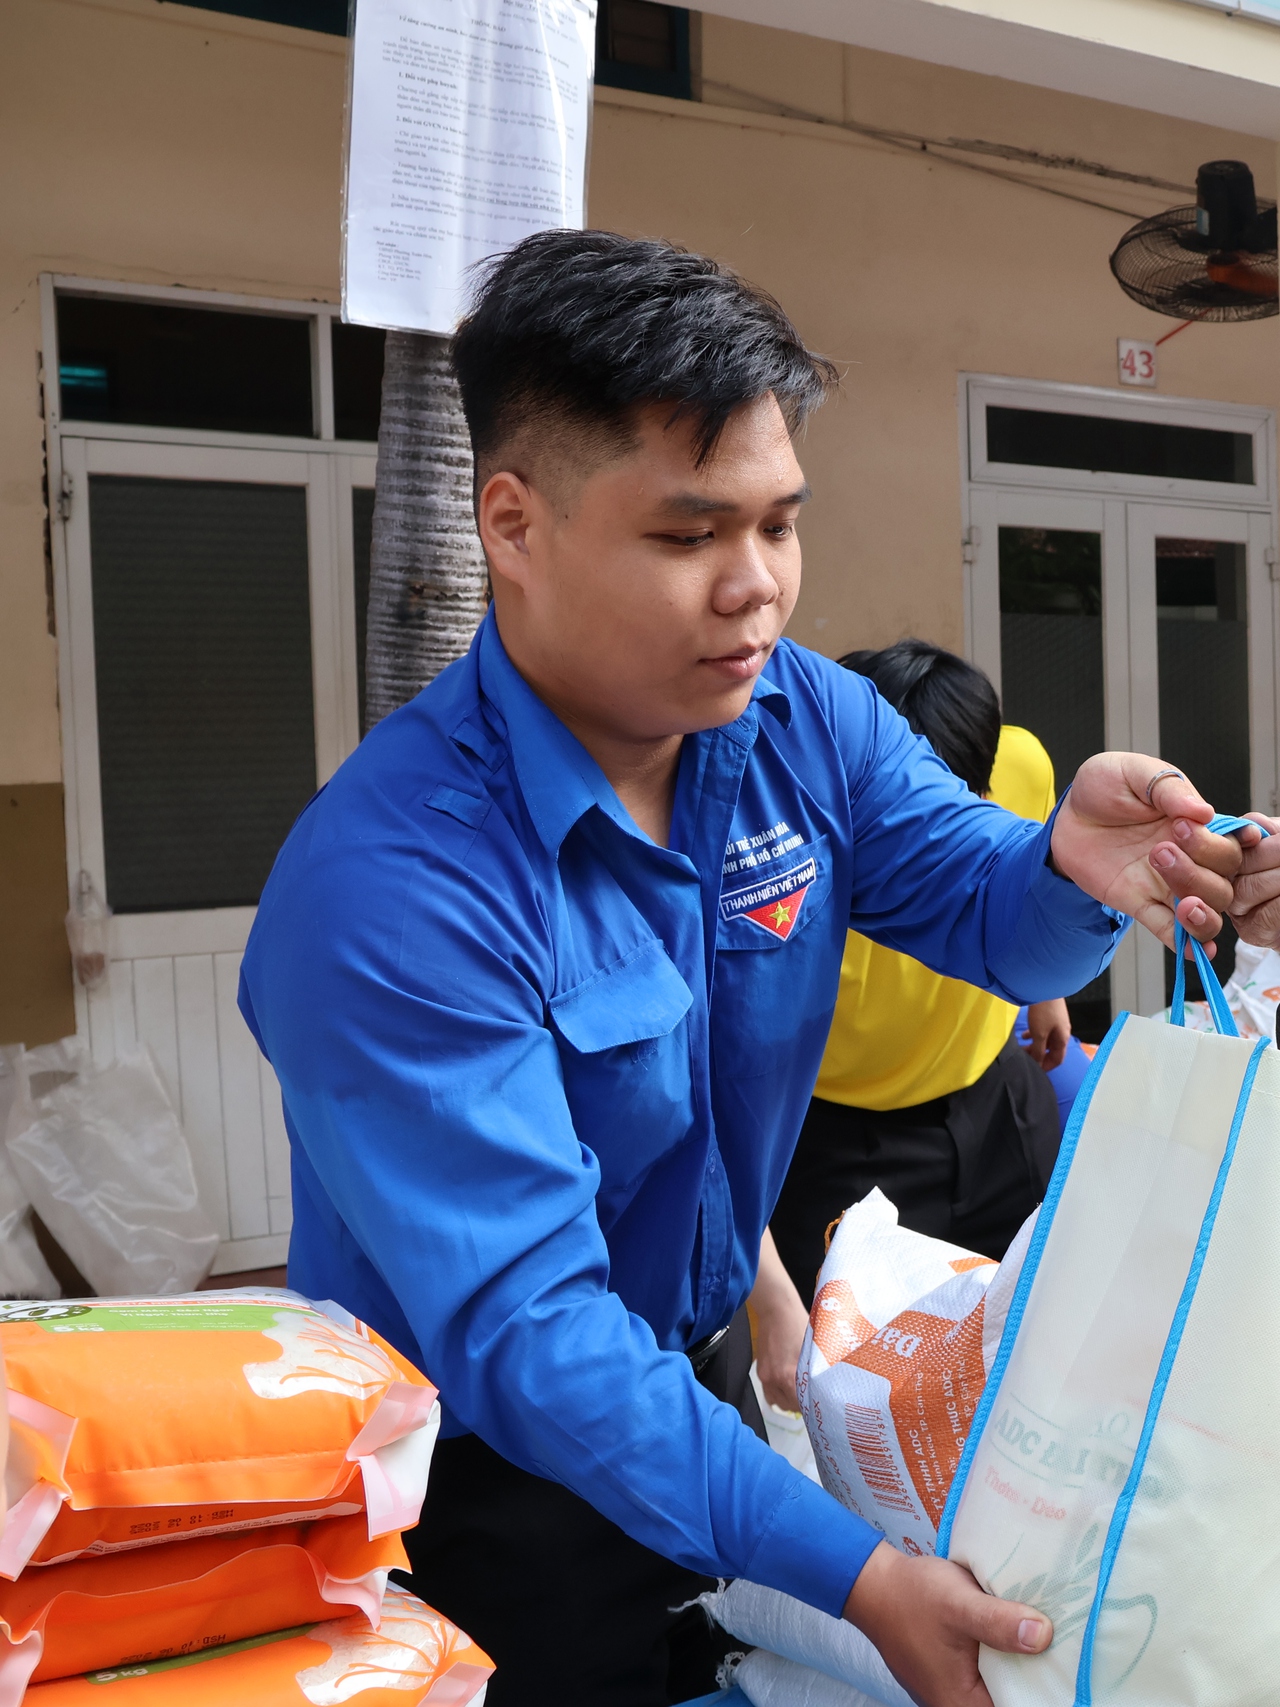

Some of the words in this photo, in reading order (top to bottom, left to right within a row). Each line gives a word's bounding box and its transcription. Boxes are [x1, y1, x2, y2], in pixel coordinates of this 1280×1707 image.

[1121, 348, 1154, 378] 43
[736, 836, 751, 852] TRẺ
[750, 829, 776, 848] XUÂN
[739, 852, 758, 869] PHỐ
[756, 848, 771, 863] HỒ
[771, 841, 786, 858] CHÍ
[784, 834, 804, 851] MINH
[722, 892, 758, 912] THANH
[754, 884, 779, 901] NIÊN
[777, 876, 797, 892] VIỆT
[796, 866, 814, 884] NAM
[942, 1369, 953, 1398] ADC
[812, 1398, 824, 1433] NSX
[920, 1418, 928, 1433] TP.
[908, 1429, 923, 1456] ADC
[994, 1408, 1042, 1457] ADC
[919, 1459, 936, 1493] TNHH
[932, 1460, 946, 1486] Ninh
[96, 1671, 118, 1682] 5
[121, 1668, 148, 1676] kg
